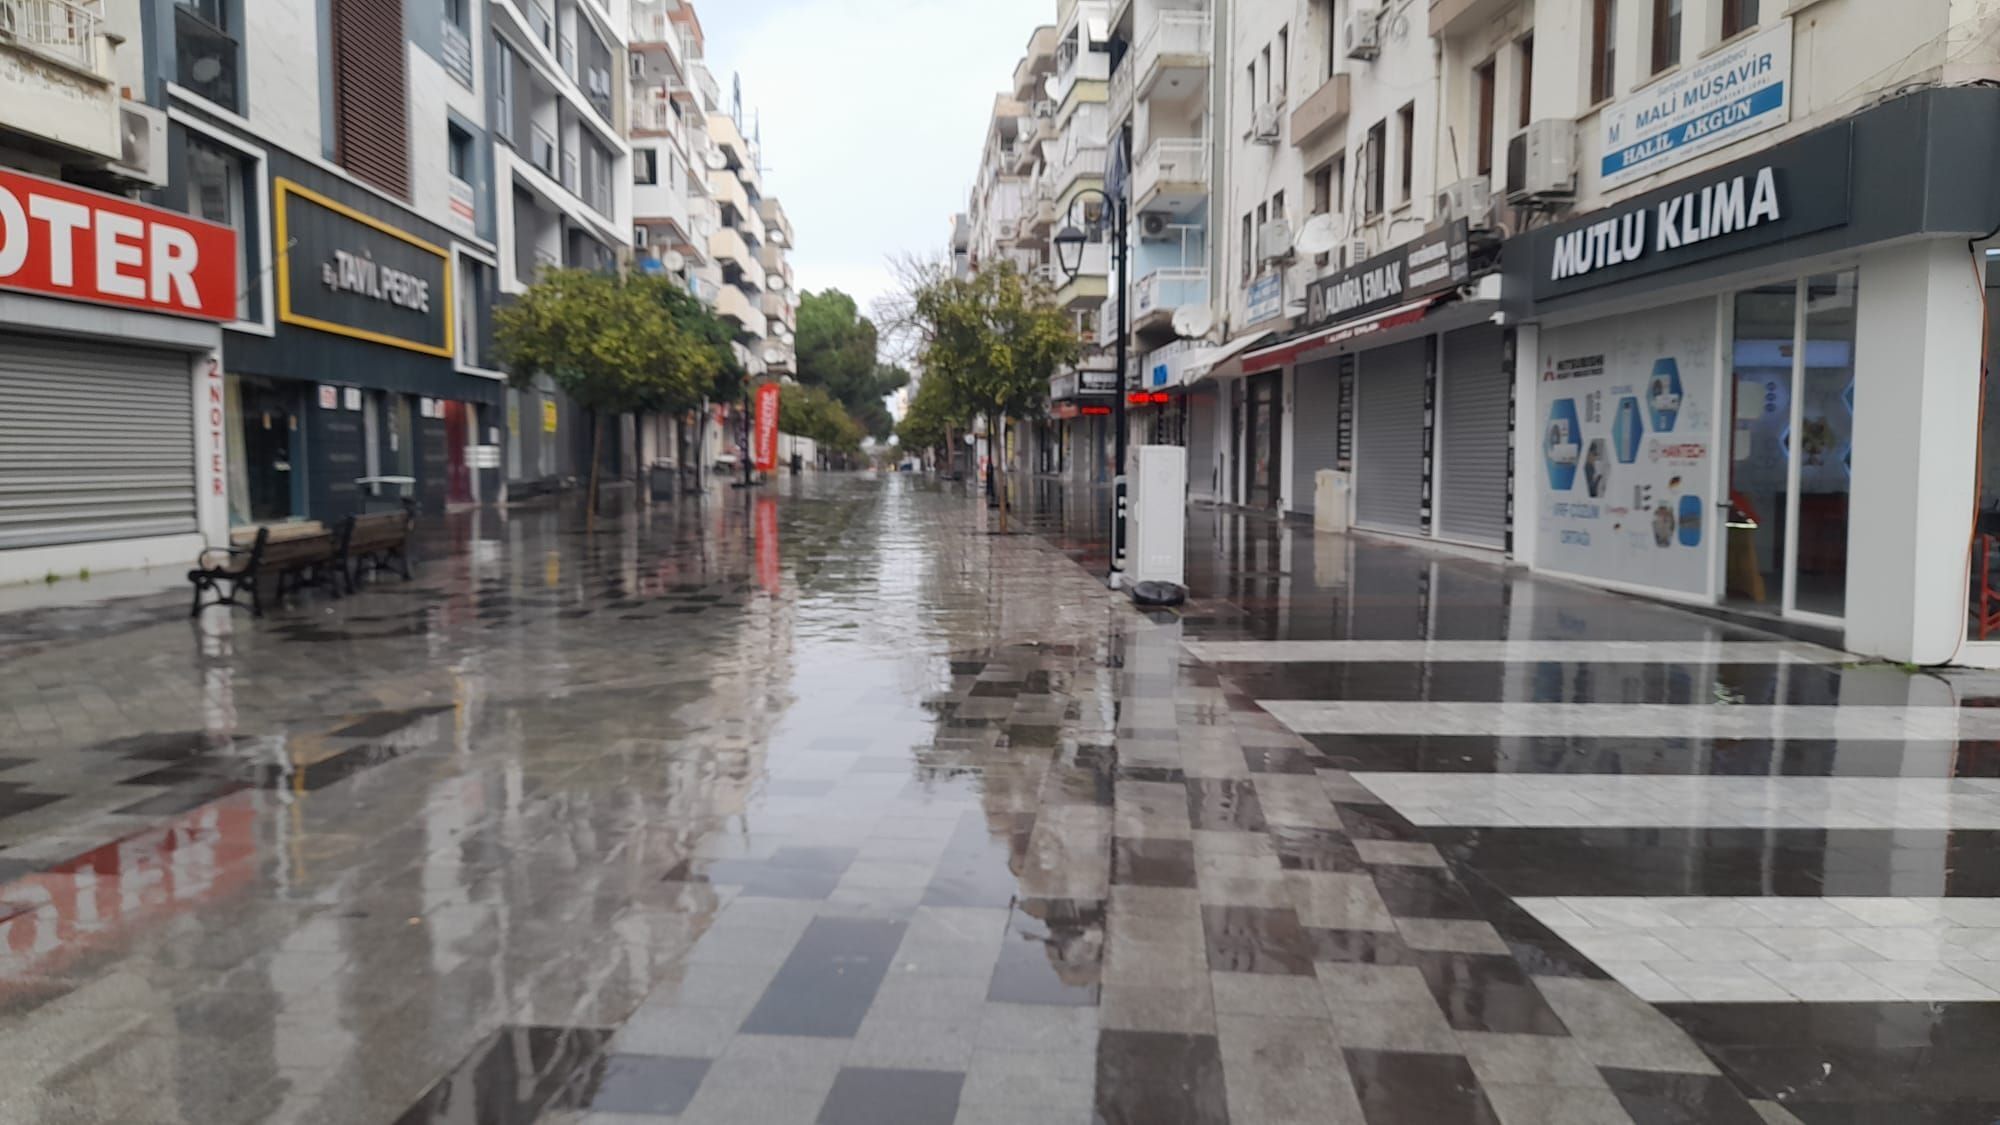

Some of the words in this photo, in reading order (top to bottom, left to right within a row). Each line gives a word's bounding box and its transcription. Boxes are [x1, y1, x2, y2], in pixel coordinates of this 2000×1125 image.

[1636, 92, 1676, 129] MALİ
[1551, 208, 1646, 280] MUTLU
[1656, 166, 1780, 252] KLIMA
[381, 265, 429, 313] PERDE
[1363, 261, 1402, 303] EMLAK
[209, 385, 224, 496] NOTER
